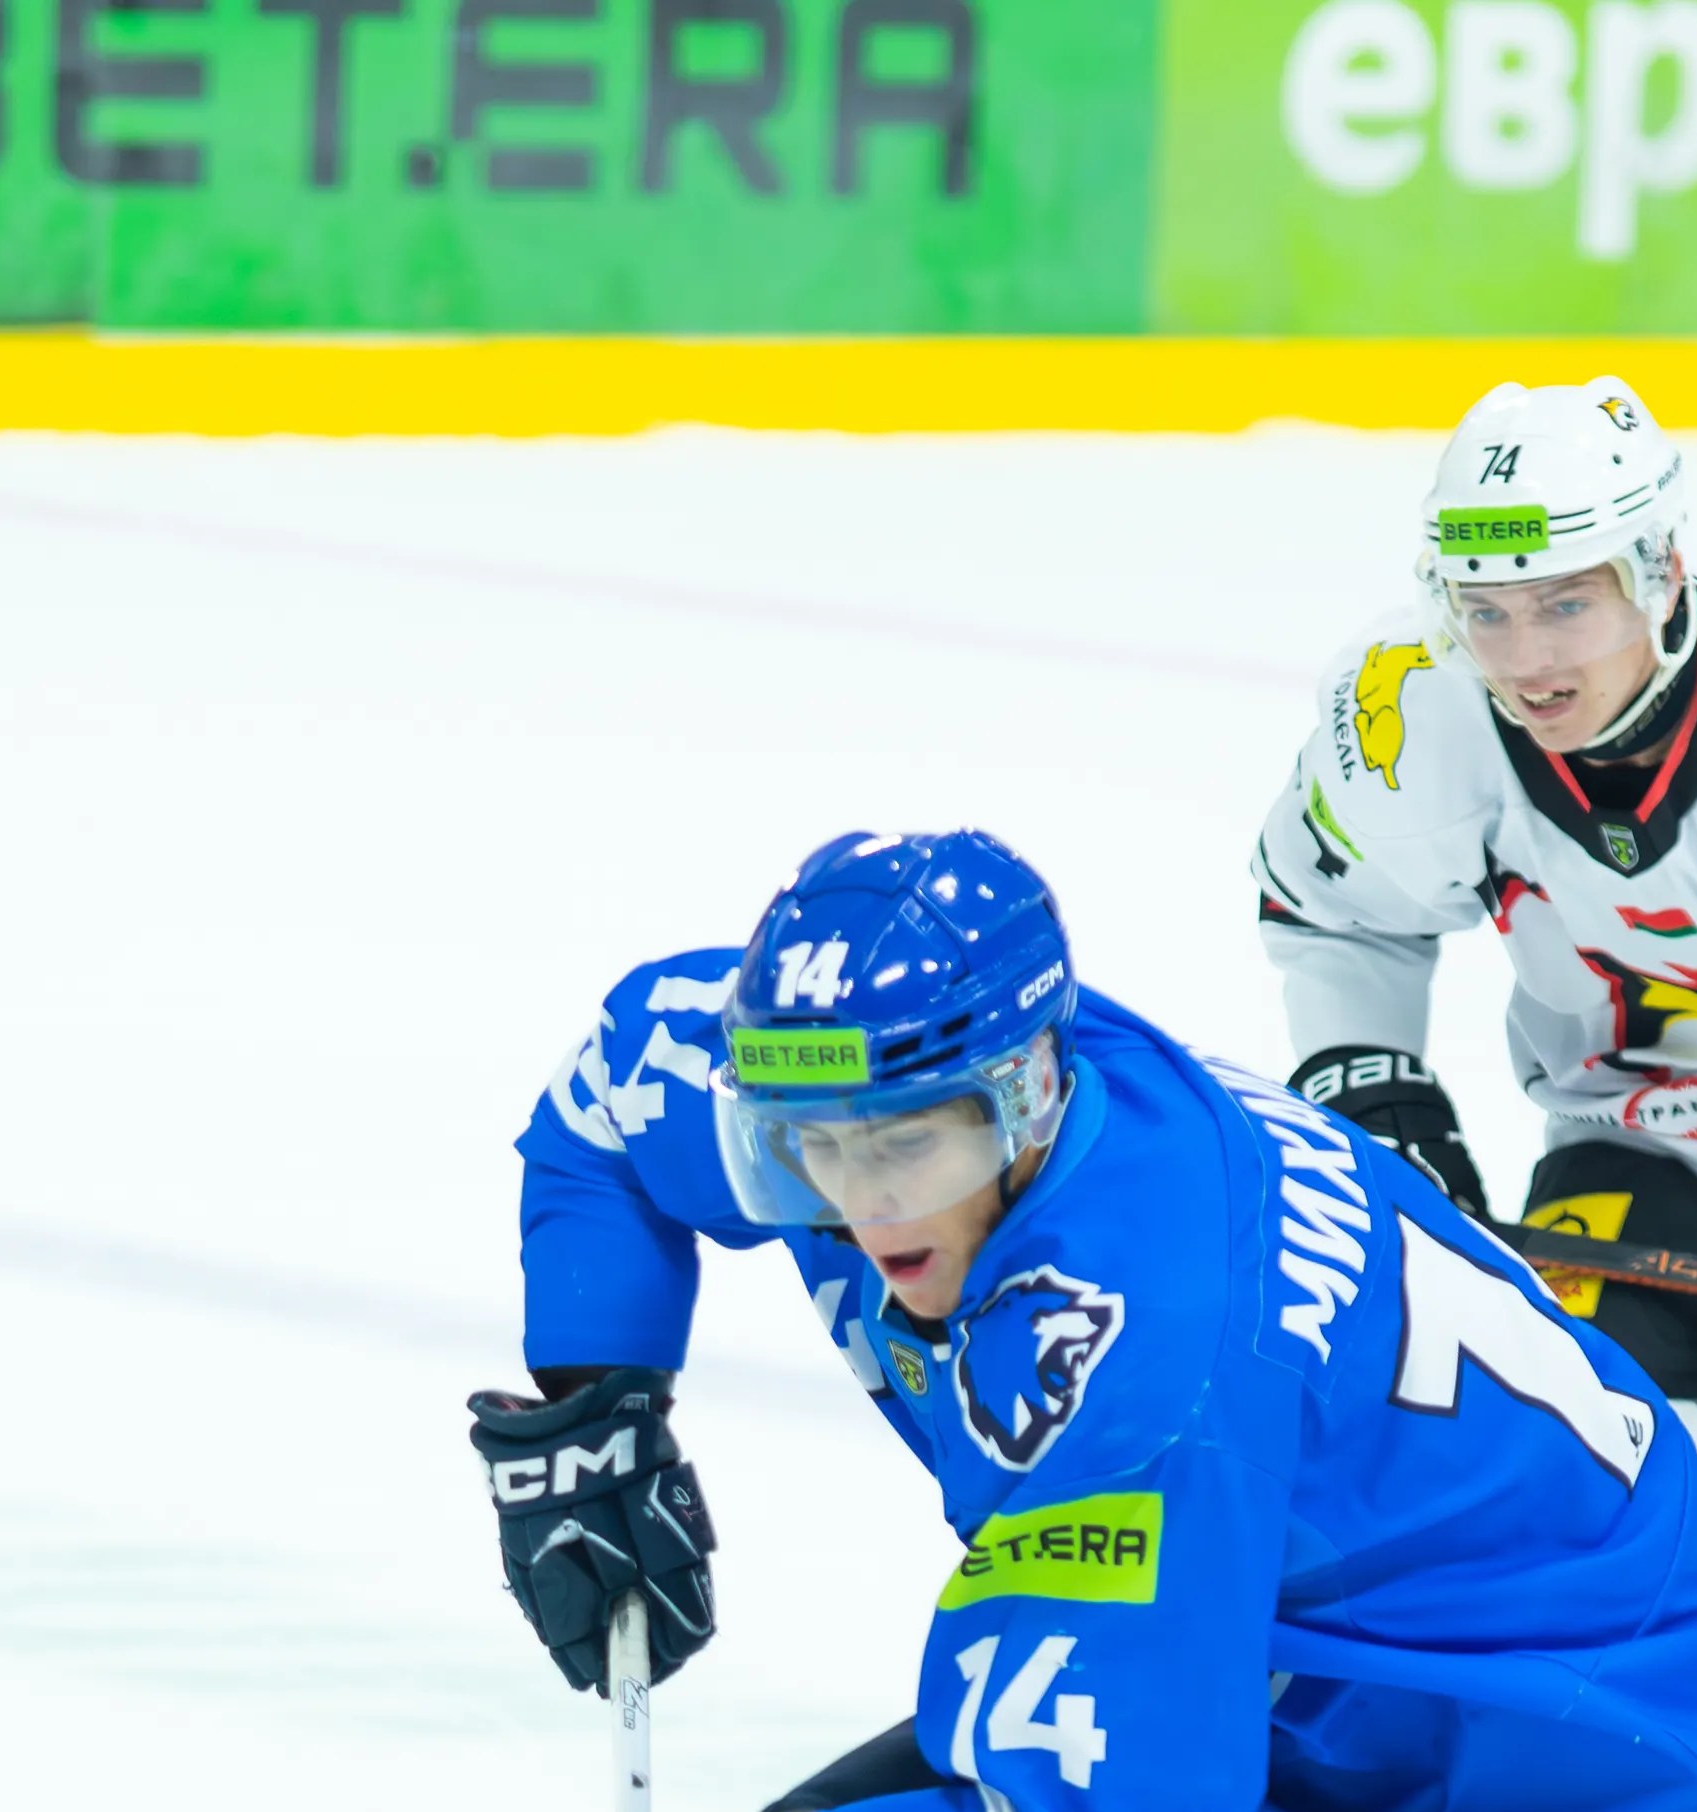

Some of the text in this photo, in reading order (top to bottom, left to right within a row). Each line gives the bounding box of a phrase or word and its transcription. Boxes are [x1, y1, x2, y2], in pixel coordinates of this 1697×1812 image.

[1479, 444, 1523, 485] 74
[773, 940, 850, 1008] 14
[1019, 959, 1065, 1011] CCM
[1385, 1198, 1657, 1500] 1
[479, 1426, 638, 1505] CM
[960, 1524, 1147, 1578] ET.ERA
[954, 1635, 1107, 1790] 14
